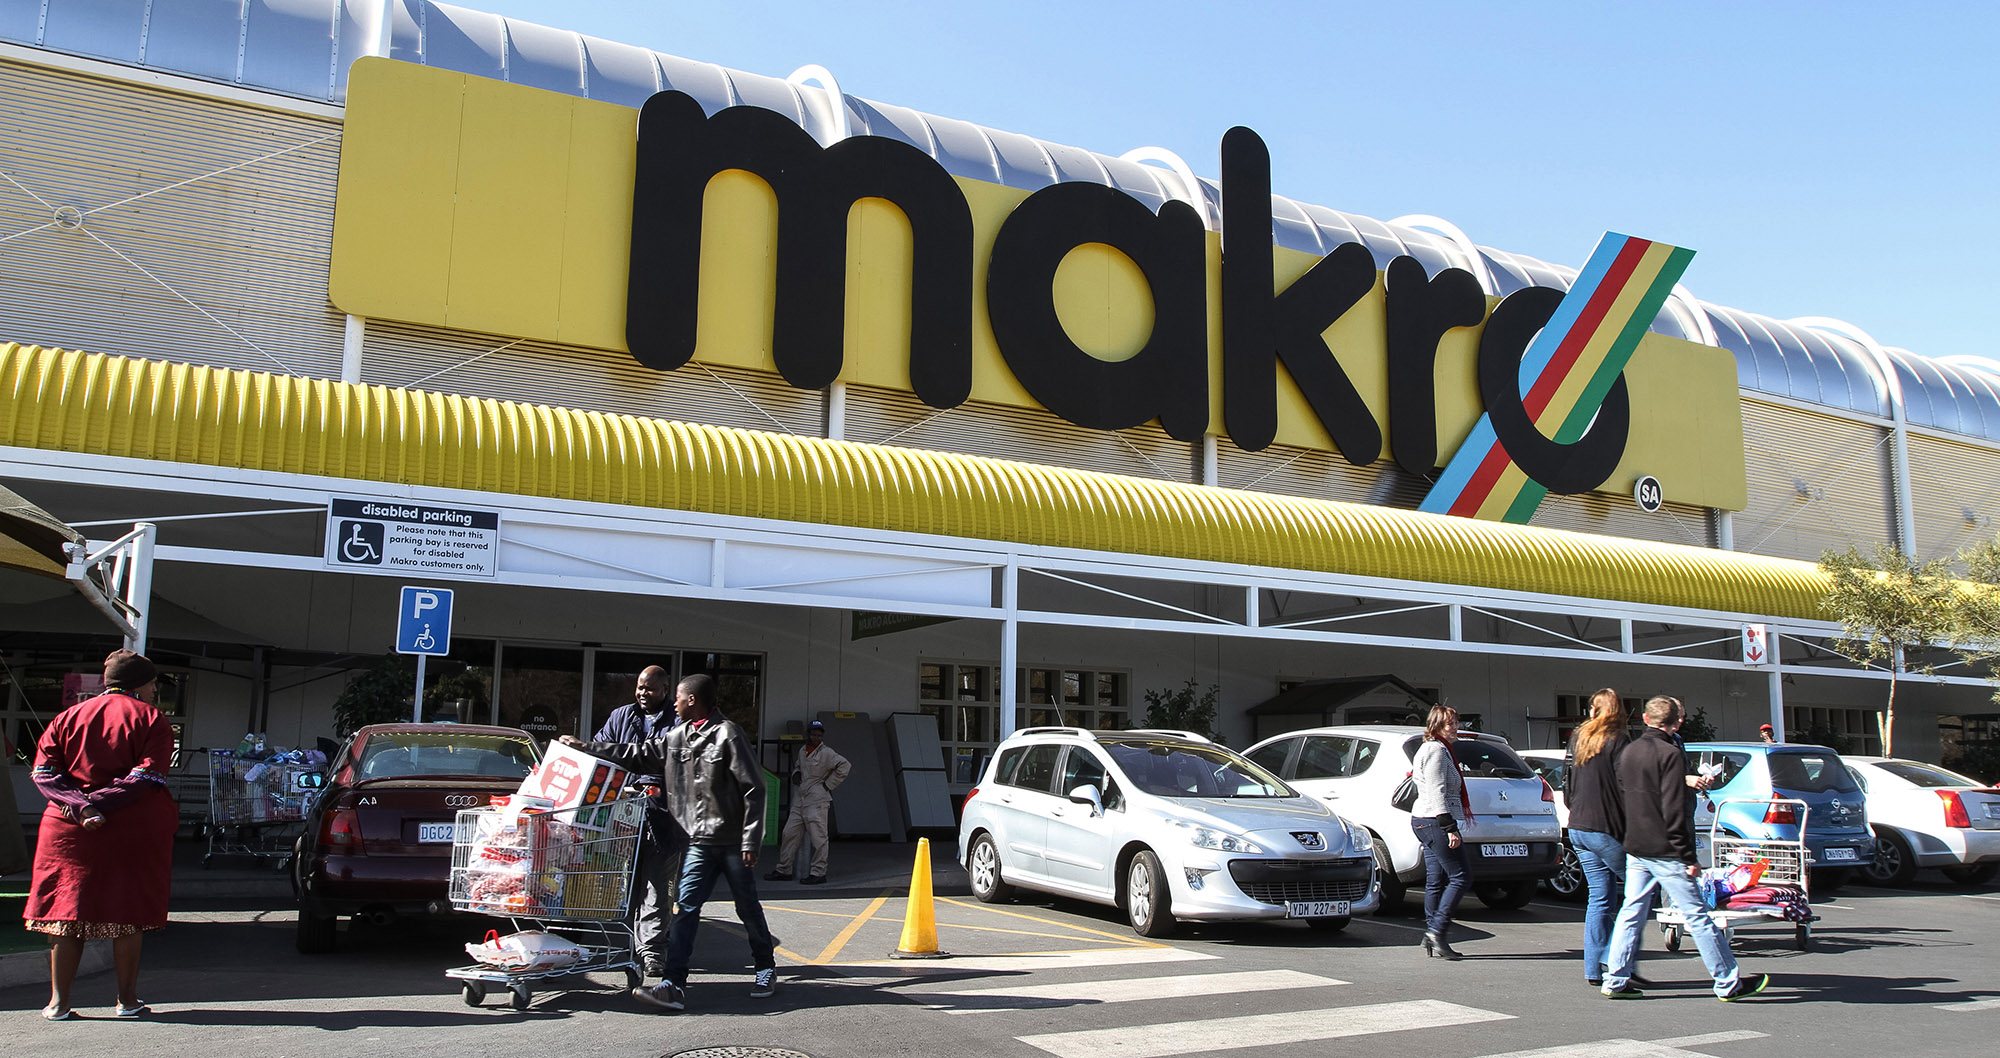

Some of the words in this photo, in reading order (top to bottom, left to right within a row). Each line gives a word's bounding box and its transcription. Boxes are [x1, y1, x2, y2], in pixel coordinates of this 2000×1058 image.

[625, 90, 1631, 495] makro
[1641, 484, 1659, 504] SA
[361, 503, 418, 520] disabled
[422, 511, 472, 526] parking
[396, 525, 425, 535] Please
[427, 528, 446, 537] note
[449, 529, 467, 538] that
[468, 530, 483, 539] this
[389, 536, 423, 547] parking
[425, 538, 442, 548] bay
[453, 541, 488, 550] reserved
[413, 548, 426, 556] for
[428, 549, 464, 559] disabled
[390, 557, 418, 566] Makro
[420, 560, 463, 570] customers
[465, 562, 485, 572] only.
[414, 592, 439, 619] P
[520, 723, 557, 732] entrance
[551, 760, 580, 779] STOP
[1483, 845, 1497, 855] ZJK
[1501, 845, 1515, 855] 723
[1519, 845, 1527, 855] GP
[1293, 903, 1309, 916] YDM
[1313, 902, 1330, 915] 227
[1337, 901, 1348, 914] GP
